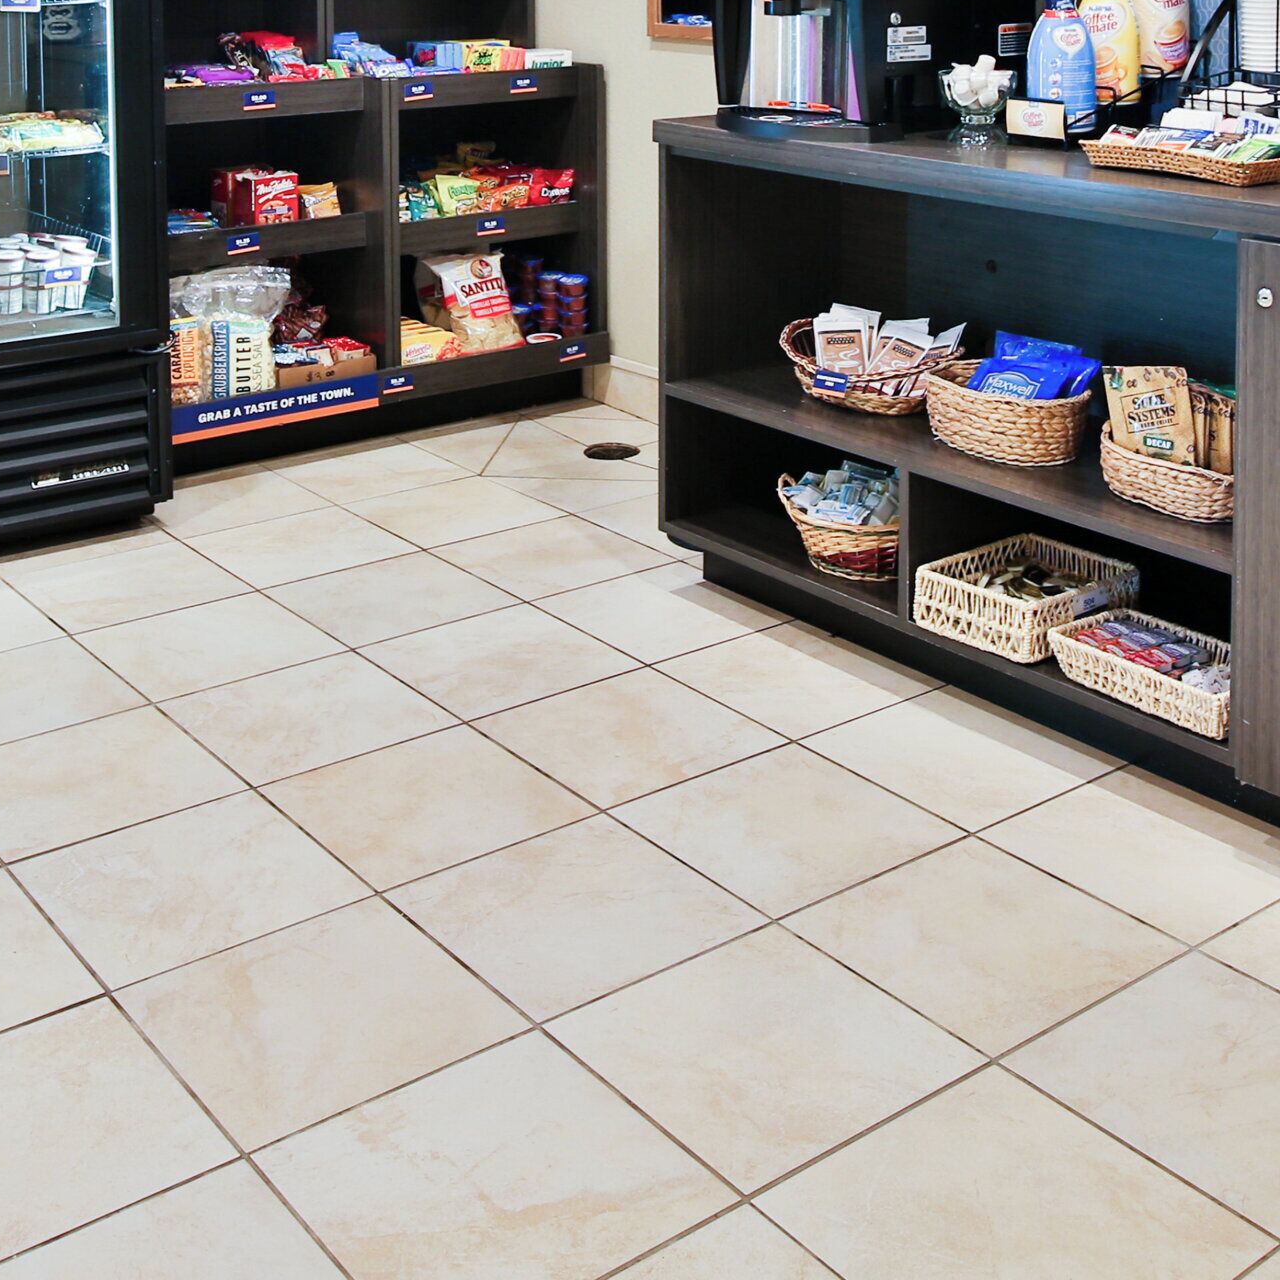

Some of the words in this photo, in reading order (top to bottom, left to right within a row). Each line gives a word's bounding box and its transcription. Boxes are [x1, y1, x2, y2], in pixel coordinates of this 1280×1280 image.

[1089, 22, 1118, 34] mate
[540, 186, 570, 198] Doritos
[182, 328, 194, 380] EXPLOSION
[236, 336, 251, 396] BUTTER
[252, 360, 262, 376] SEA
[986, 375, 1032, 396] Maxwell
[198, 408, 231, 424] GRAB
[232, 406, 242, 418] A
[244, 400, 278, 416] TASTE
[280, 398, 296, 409] OF
[297, 394, 318, 406] THE
[318, 386, 355, 402] TOWN.
[1127, 405, 1176, 424] SYSTEMS
[1146, 438, 1174, 450] DECAF
